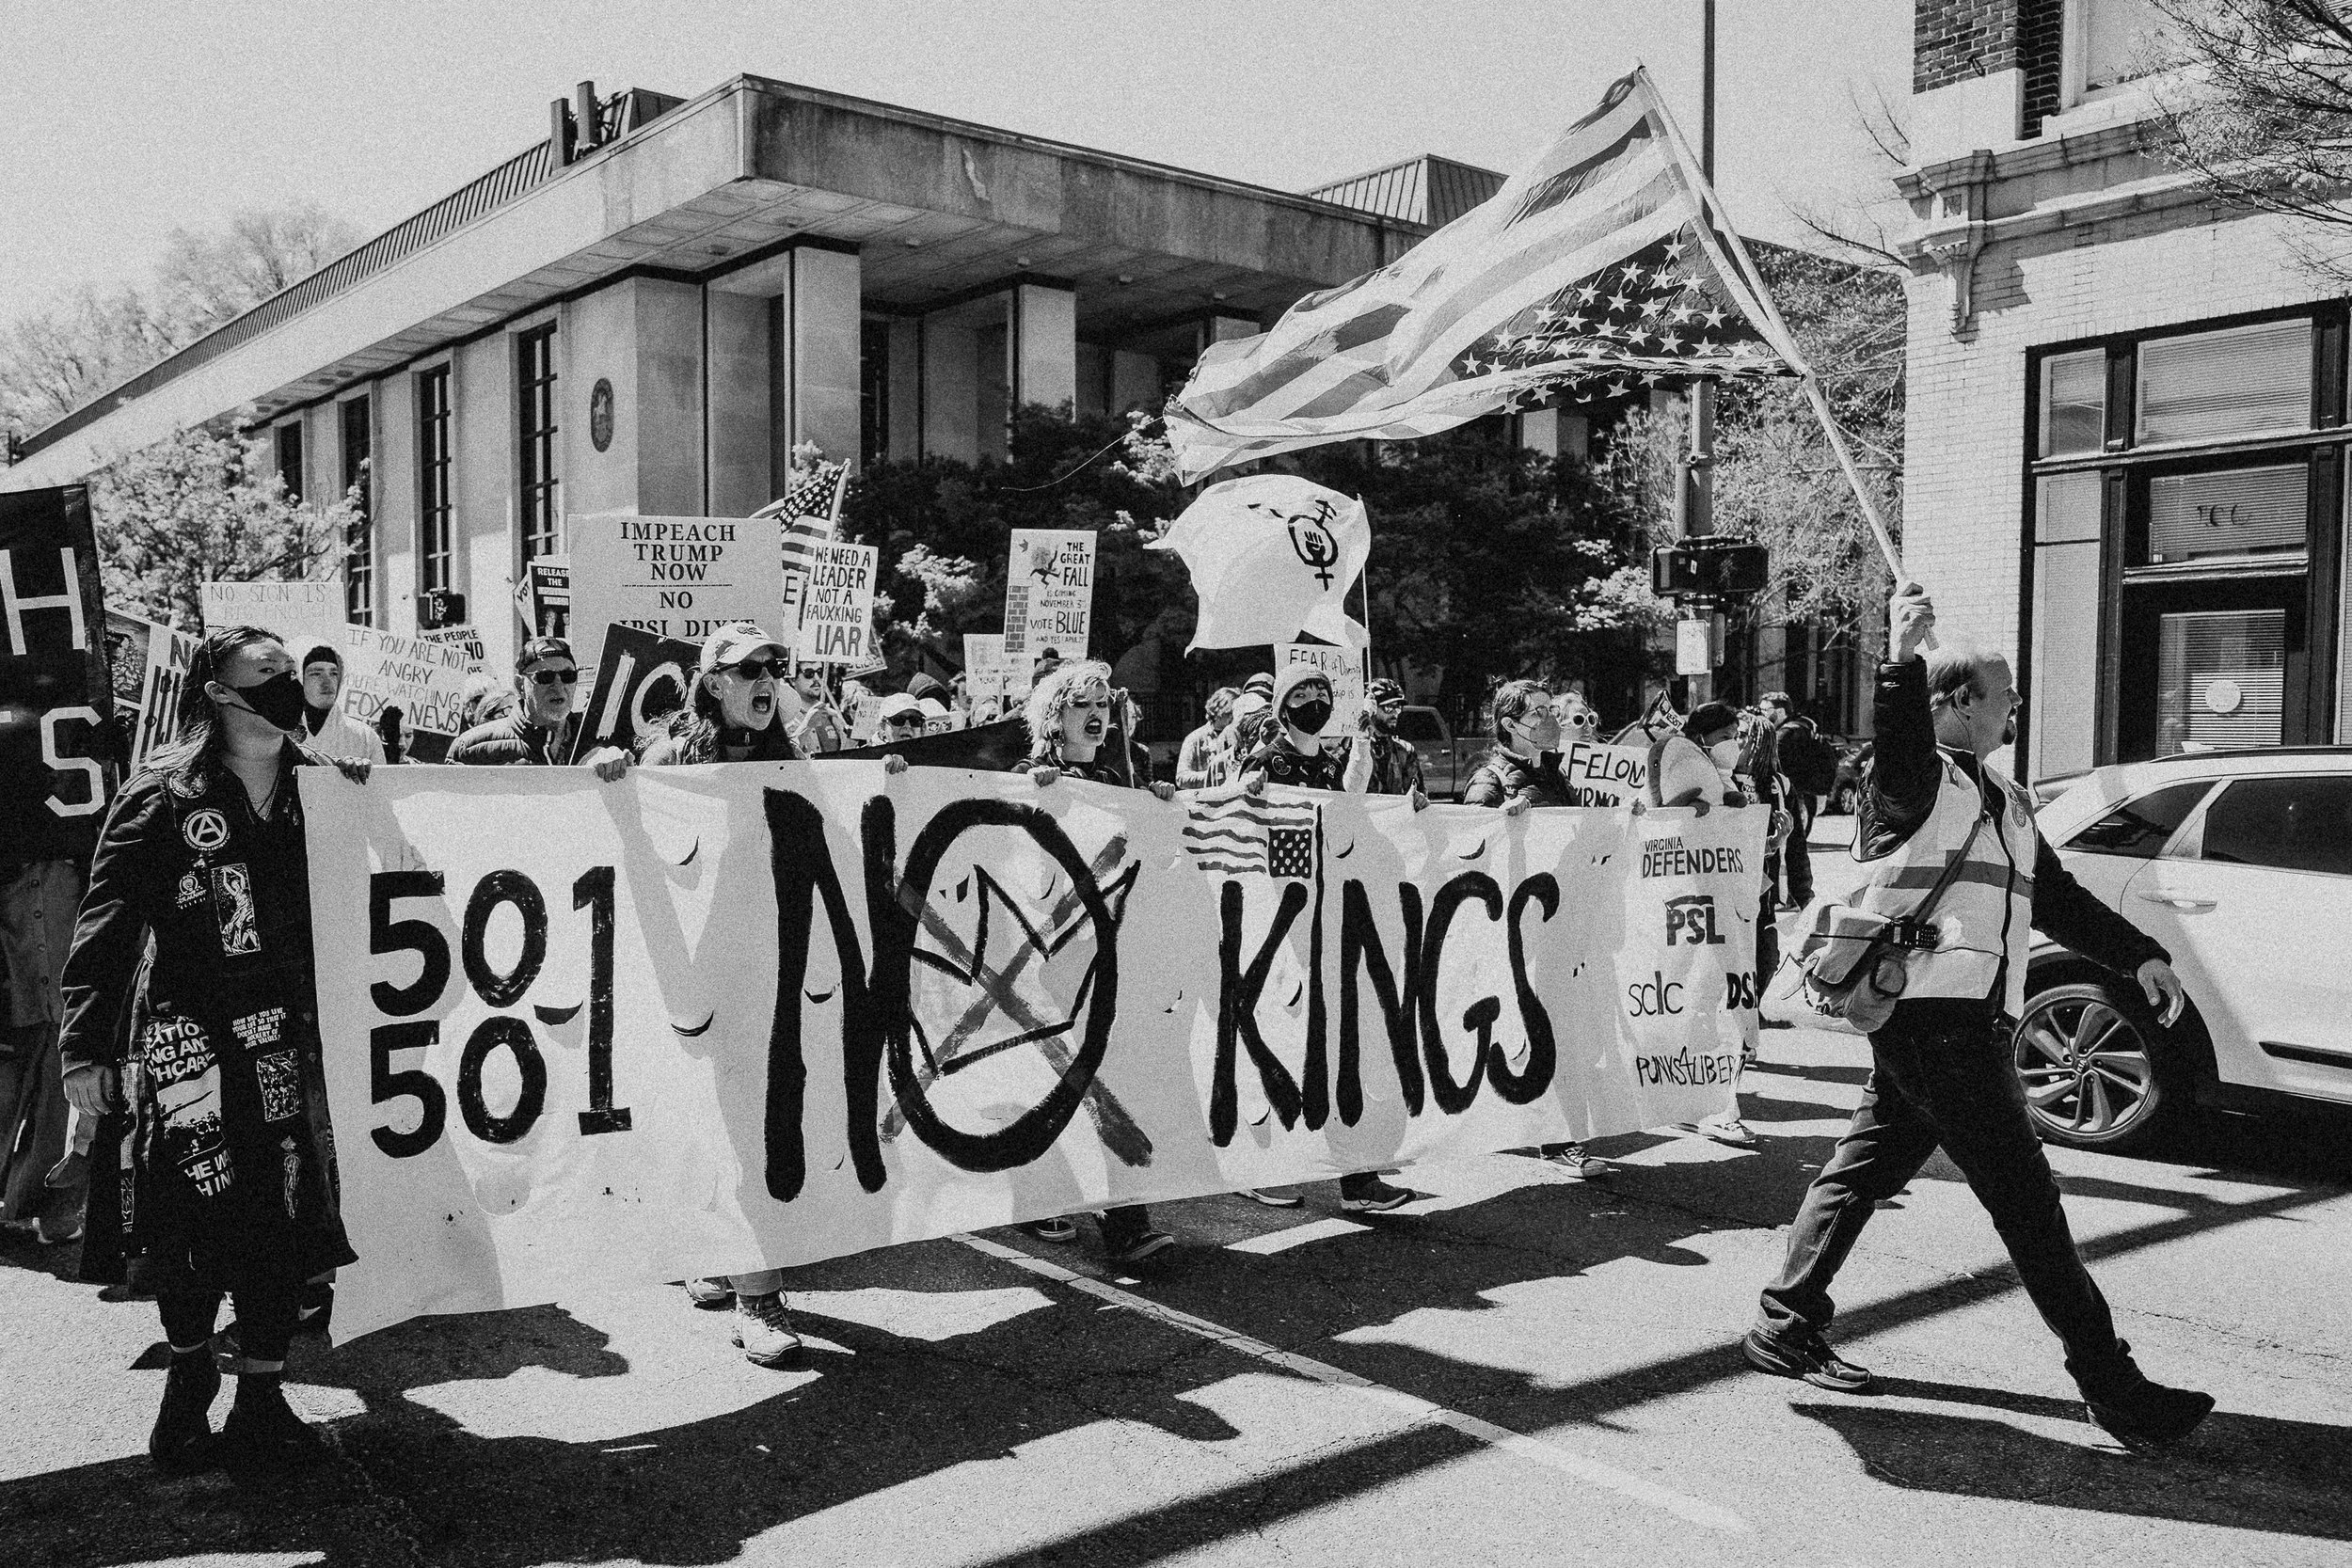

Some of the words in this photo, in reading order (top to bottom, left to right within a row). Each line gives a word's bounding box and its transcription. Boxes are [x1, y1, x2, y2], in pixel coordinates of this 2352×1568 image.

[620, 521, 737, 542] IMPEACH
[633, 543, 723, 562] TRUMP
[1067, 542, 1084, 551] THE
[816, 546, 828, 563] WE
[831, 548, 859, 566] NEED
[862, 551, 870, 568] A
[1060, 553, 1090, 564] GREAT
[650, 562, 708, 581] NOW
[813, 564, 866, 589] LEADER
[1063, 566, 1088, 587] FALL
[547, 578, 563, 586] THE
[211, 585, 235, 602] NO
[660, 591, 693, 610] NO
[816, 588, 839, 605] NOT
[843, 590, 852, 605] A
[1040, 599, 1074, 609] NOVEMBER
[1030, 618, 1053, 629] VOTE
[1056, 610, 1086, 634] BLUE
[423, 634, 443, 643] THE
[444, 629, 479, 641] PEOPLE
[816, 624, 861, 657] LIAR
[348, 628, 372, 646] IF
[380, 635, 405, 655] YOU
[408, 641, 437, 664] ARE
[441, 648, 469, 672] NOT
[1290, 648, 1327, 672] FEAR
[378, 659, 433, 685] ANGRY
[343, 689, 389, 718] FOX
[408, 701, 460, 733] NEWS
[40, 705, 105, 816] S
[1645, 836, 1684, 852] VIRGINIA
[1642, 847, 1744, 879] DEFENDERS
[1666, 906, 1725, 946] PSL
[763, 786, 1118, 1202] NO
[1208, 870, 1561, 1148] KINGS
[231, 1023, 246, 1033] YOUR
[247, 1021, 256, 1029] LIFE
[265, 1014, 279, 1023] THAT
[232, 1017, 246, 1026] HOW
[247, 1030, 270, 1042] MOCKERY
